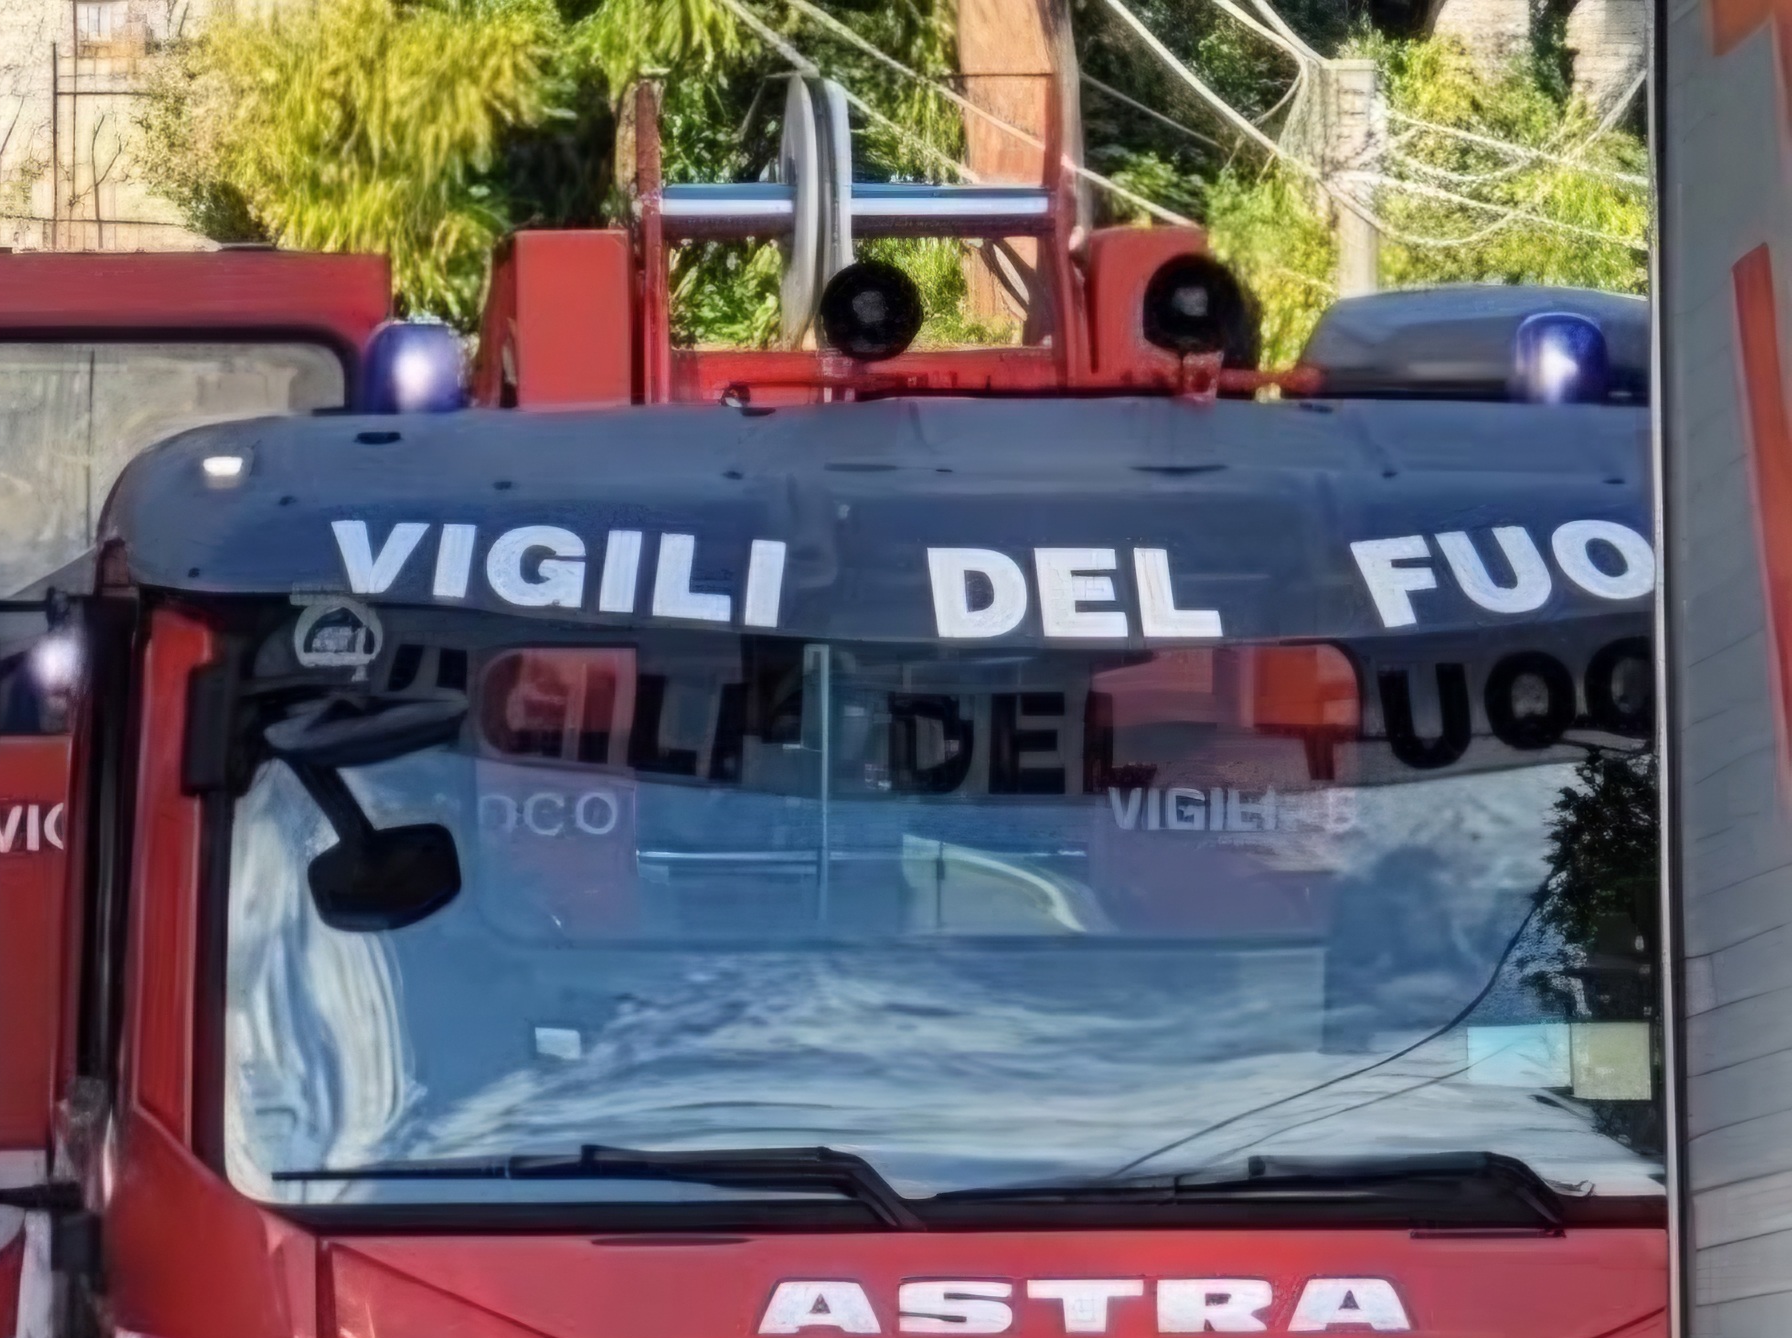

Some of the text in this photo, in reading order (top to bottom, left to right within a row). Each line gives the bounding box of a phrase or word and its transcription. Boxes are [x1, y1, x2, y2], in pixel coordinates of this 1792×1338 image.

[330, 519, 787, 628] VIGILI
[927, 547, 1223, 638] DEL
[757, 1277, 1411, 1334] ASTRA
